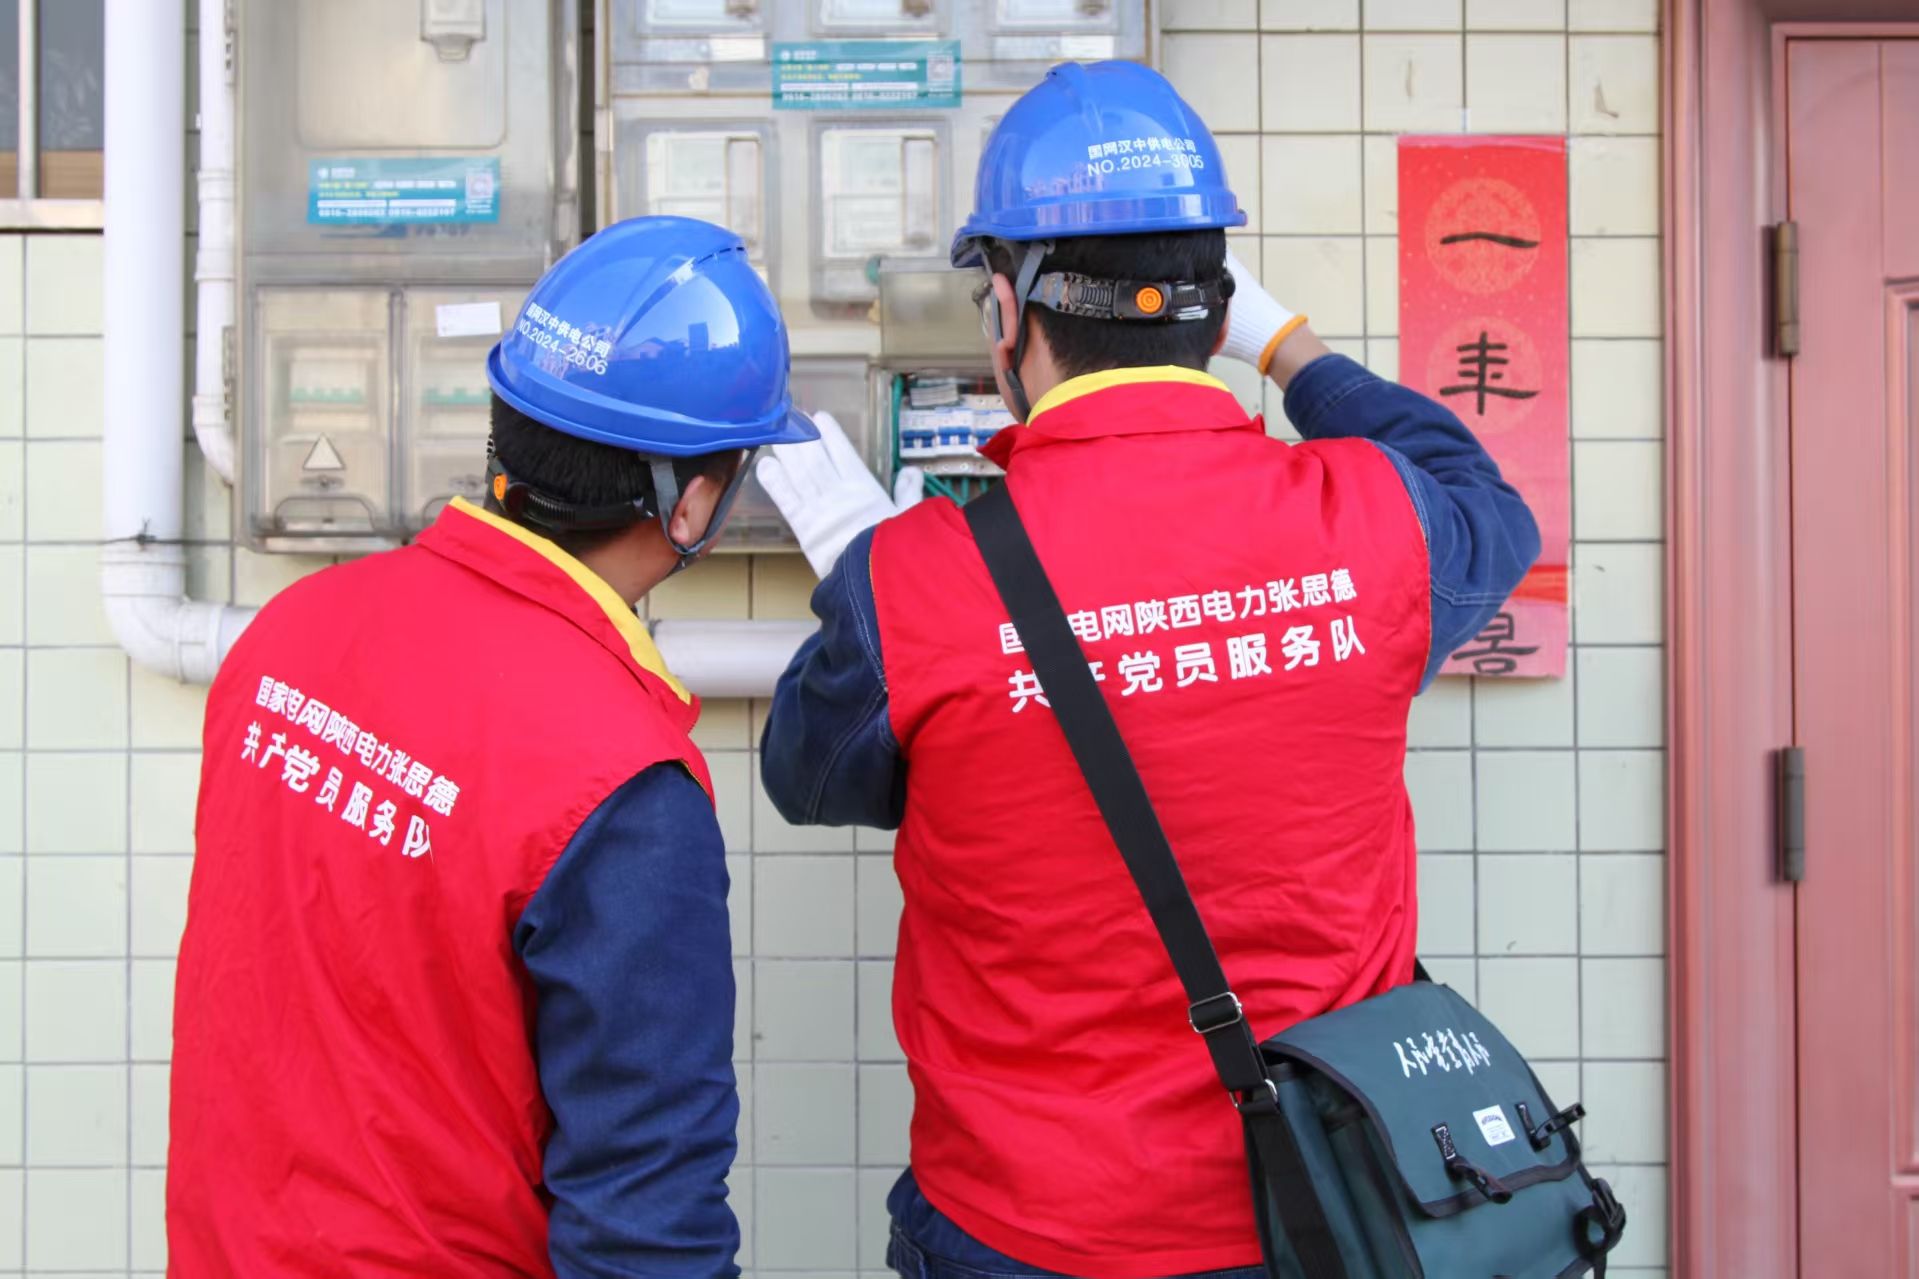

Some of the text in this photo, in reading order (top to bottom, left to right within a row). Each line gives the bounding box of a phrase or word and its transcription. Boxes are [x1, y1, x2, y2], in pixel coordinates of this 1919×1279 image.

[1087, 137, 1197, 160] 国网汉中供电公司
[517, 318, 608, 375] NO.2024-2606
[526, 302, 611, 358] 国网汉中供电公司
[999, 568, 1357, 655] 国电网陕西电力张思德
[1008, 615, 1366, 713] 共党员服务队
[255, 675, 460, 816] 国家电网陕西电力张思德
[241, 720, 434, 864] 共产党员服务队
